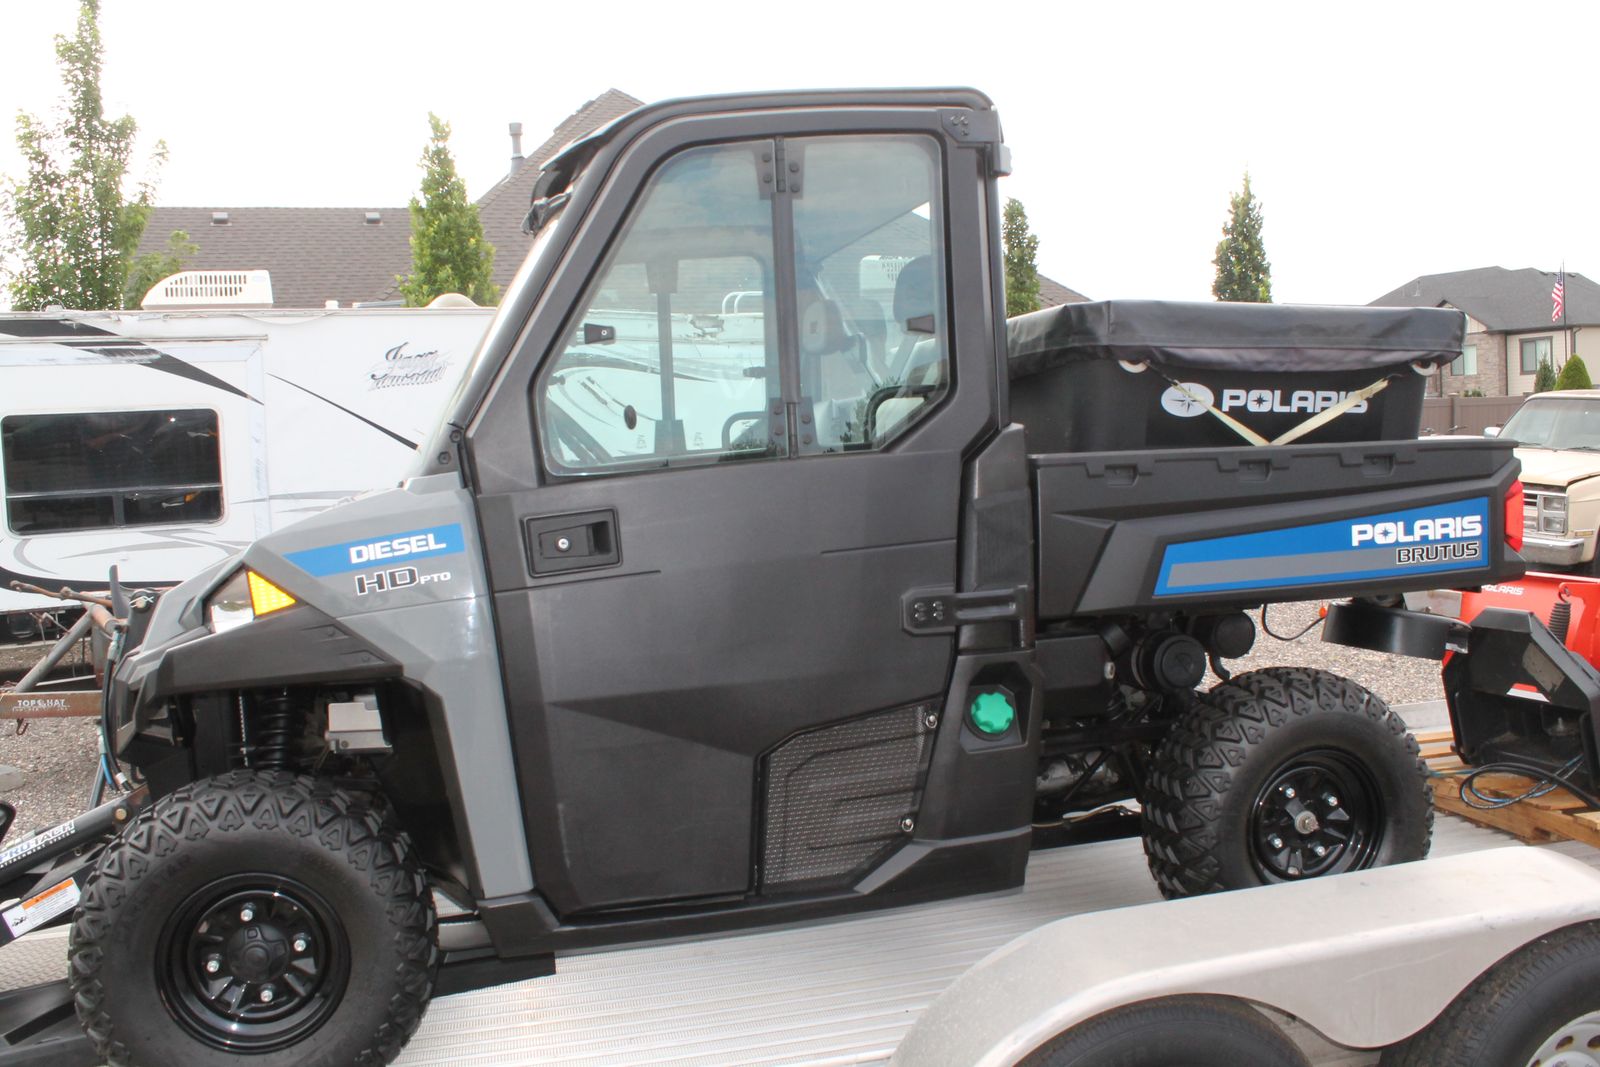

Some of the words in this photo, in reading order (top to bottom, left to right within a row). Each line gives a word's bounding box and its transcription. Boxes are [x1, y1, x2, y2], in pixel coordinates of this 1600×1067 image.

[1351, 515, 1482, 547] POLARIS
[349, 533, 447, 564] DIESEL
[1396, 541, 1480, 565] BRUTUS
[355, 566, 419, 596] HD
[420, 571, 451, 585] PTO
